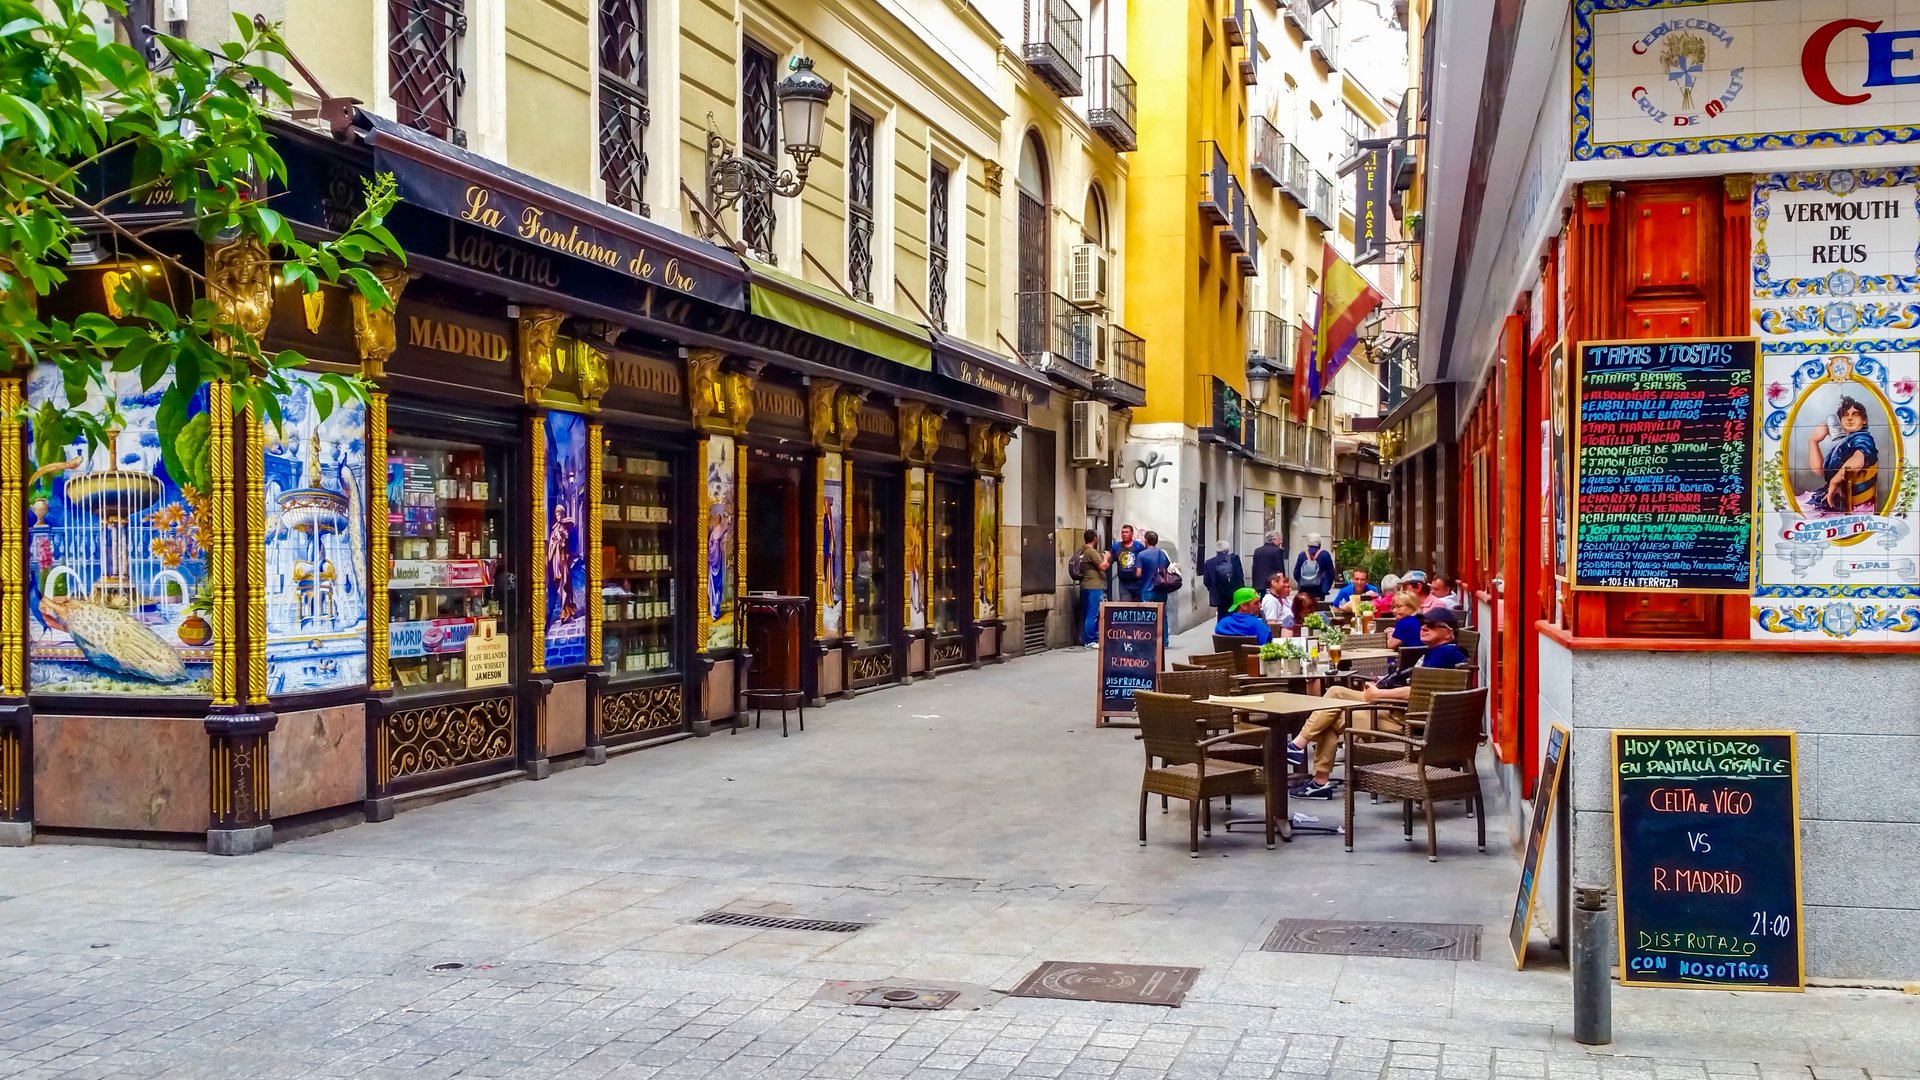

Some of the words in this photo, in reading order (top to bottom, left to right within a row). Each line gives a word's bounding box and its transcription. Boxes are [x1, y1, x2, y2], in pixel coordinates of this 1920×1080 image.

[1632, 18, 1734, 55] CERVECERIA
[1631, 86, 1668, 123] CRUZ
[1673, 115, 1700, 126] DE
[1704, 66, 1745, 119] MALTA
[1367, 172, 1374, 191] EL
[145, 189, 181, 206] 199
[1783, 200, 1899, 222] VERMOUTH
[461, 186, 506, 228] La
[518, 206, 622, 267] Fontana
[629, 248, 656, 279] de
[664, 257, 697, 292] Oro
[1830, 225, 1852, 241] DE
[1812, 244, 1868, 264] REUS
[408, 316, 508, 362] MADRID
[1588, 346, 1651, 366] TAPAS
[1668, 344, 1733, 365] TOSTAS
[612, 359, 682, 396] MADRID
[976, 367, 1008, 394] Fontana
[1590, 372, 1637, 385] PATATAS
[1640, 373, 1683, 383] BRAVAS
[1642, 382, 1687, 391] SALSAS
[1590, 390, 1657, 400] ALBONDIGAS
[754, 389, 805, 417] MADRID
[1588, 399, 1666, 411] ENSALADILLA
[1670, 399, 1703, 409] RUSA
[1588, 410, 1638, 421] MORCILLA
[1642, 411, 1655, 419] DE
[1657, 409, 1700, 420] BURGOS
[858, 412, 895, 436] MADRID
[1588, 422, 1615, 433] TAPA
[1620, 420, 1681, 432] MARAVILLA
[1588, 434, 1634, 446] TORTILLA
[1640, 432, 1680, 444] PINCHO
[1588, 444, 1651, 456] CROQUETAS
[1654, 444, 1668, 454] DE
[1672, 442, 1708, 454] JAMON
[1588, 457, 1625, 467] JAMON
[1588, 467, 1618, 476] LOMO
[1587, 475, 1620, 485] QUESO
[1624, 475, 1681, 484] MANCHEGO
[1586, 485, 1615, 494] QUESO
[1619, 484, 1631, 493] DE
[1634, 484, 1664, 492] OVEJA
[1666, 484, 1676, 492] AL
[1679, 483, 1714, 493] ROMERO
[1585, 493, 1638, 503] CHORIZO
[1586, 504, 1627, 513] CECINA
[1638, 504, 1701, 513] ALMENDRAS
[1585, 513, 1652, 524] CALAMARES
[1678, 513, 1728, 524] ANDALUZA
[1795, 515, 1874, 532] CERVECERIA
[1588, 524, 1620, 535] TOSTA
[1623, 524, 1664, 533] SALMON
[1783, 530, 1821, 542] CRUZ
[1826, 525, 1847, 538] DE
[1853, 521, 1898, 535] MALTA
[1586, 534, 1609, 542] TOSTA
[1583, 542, 1630, 551] SOLOMILLO
[1639, 542, 1670, 551] QUESO
[1672, 541, 1696, 550] BRIE
[1583, 551, 1624, 560] PIMIENTOS
[1632, 551, 1681, 560] VENTRESCA
[1583, 561, 1631, 569] SOBRASADA
[1850, 562, 1890, 570] TAPAS
[1581, 569, 1622, 577] CABRALES
[1632, 569, 1668, 577] ANCHOAS
[1623, 578, 1635, 587] EN
[1637, 577, 1679, 588] TERRAZA
[1112, 610, 1157, 622] PARTIDAZO
[391, 630, 422, 646] MADRID
[1123, 642, 1133, 651] VS
[469, 653, 482, 662] CAFE
[483, 651, 507, 661] IRLANDES
[484, 661, 505, 670] WHISKEY
[475, 670, 502, 681] JAMESON
[1106, 677, 1153, 687] DISFRUTALO
[1624, 739, 1661, 757] HOY
[1664, 739, 1760, 757] PARTIDAZO
[1619, 762, 1641, 774] EN
[1646, 757, 1716, 774] PANTALLA
[1718, 756, 1790, 774] GIGANTE
[1650, 787, 1697, 812] CELTA
[1699, 803, 1709, 813] DE
[1712, 787, 1753, 815] VIGO
[1687, 831, 1711, 853] VS
[1675, 869, 1743, 895] MADRID
[1750, 911, 1791, 937] 21:00
[1631, 956, 1667, 970] CON
[1679, 960, 1769, 979] NOSOTROS
